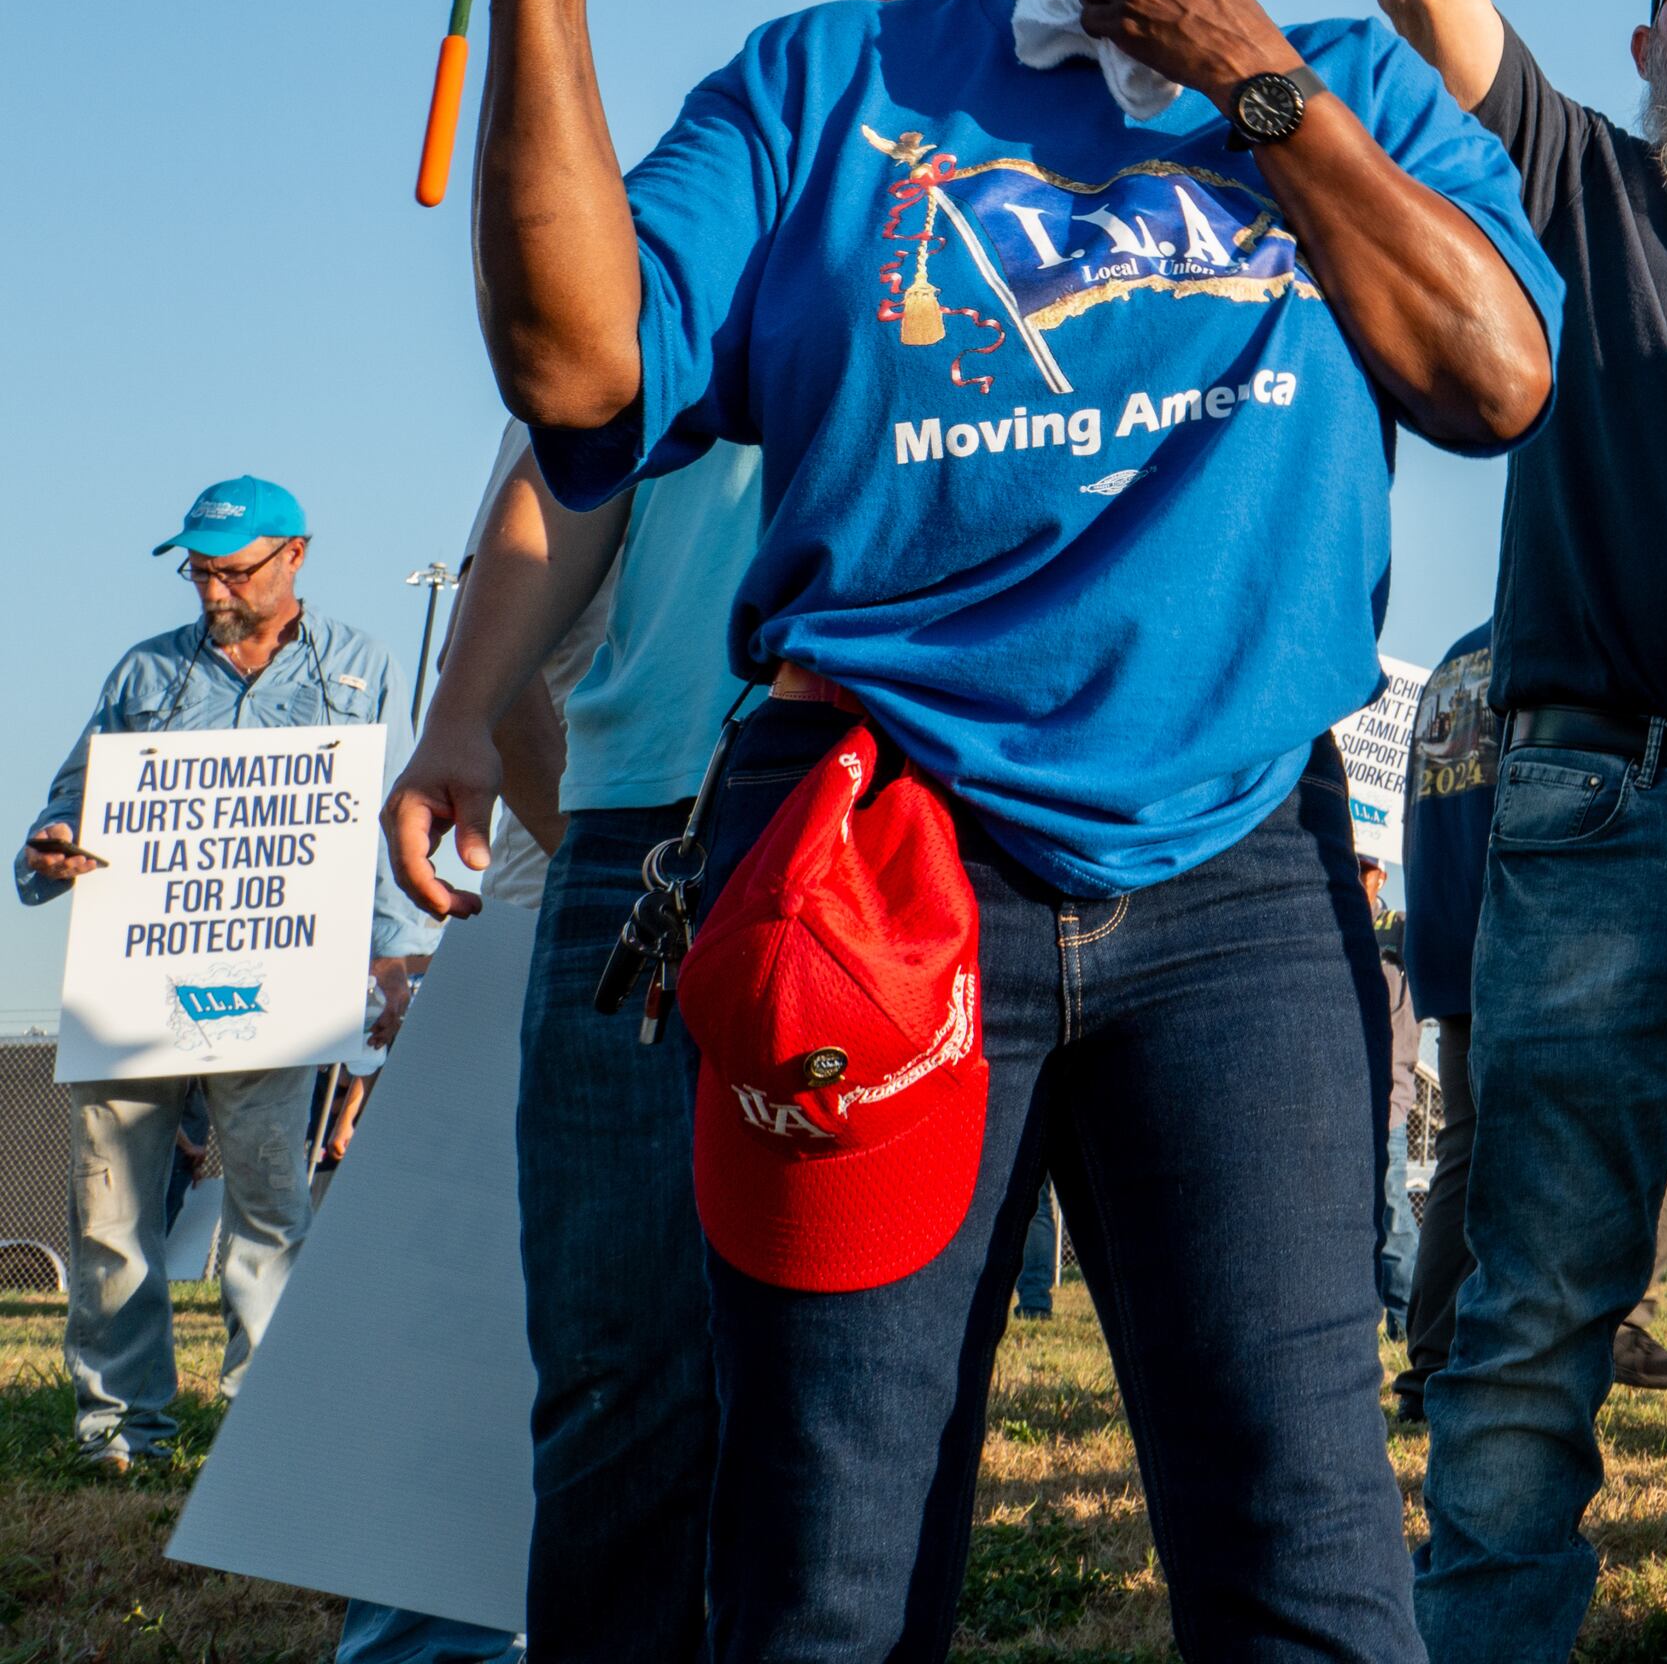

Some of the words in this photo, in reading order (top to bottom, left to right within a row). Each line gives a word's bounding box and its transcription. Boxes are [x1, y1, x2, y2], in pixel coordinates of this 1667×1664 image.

[1082, 257, 1139, 283] Local
[1158, 259, 1215, 276] Union
[895, 406, 1102, 465] Moving
[1115, 368, 1297, 437] Ameca
[1340, 733, 1407, 768] SUPPORT
[137, 753, 333, 792] AUTOMATION
[1419, 755, 1483, 797] 2024
[103, 797, 205, 835] HURTS
[213, 791, 359, 829] FAMILIES:
[141, 839, 188, 874] ILA
[197, 833, 316, 871] STANDS
[164, 879, 223, 914] FOR
[231, 875, 285, 910] JOB
[125, 914, 316, 958] PROTECTION
[189, 991, 256, 1013] I.L.A.
[731, 1084, 835, 1137] ILA
